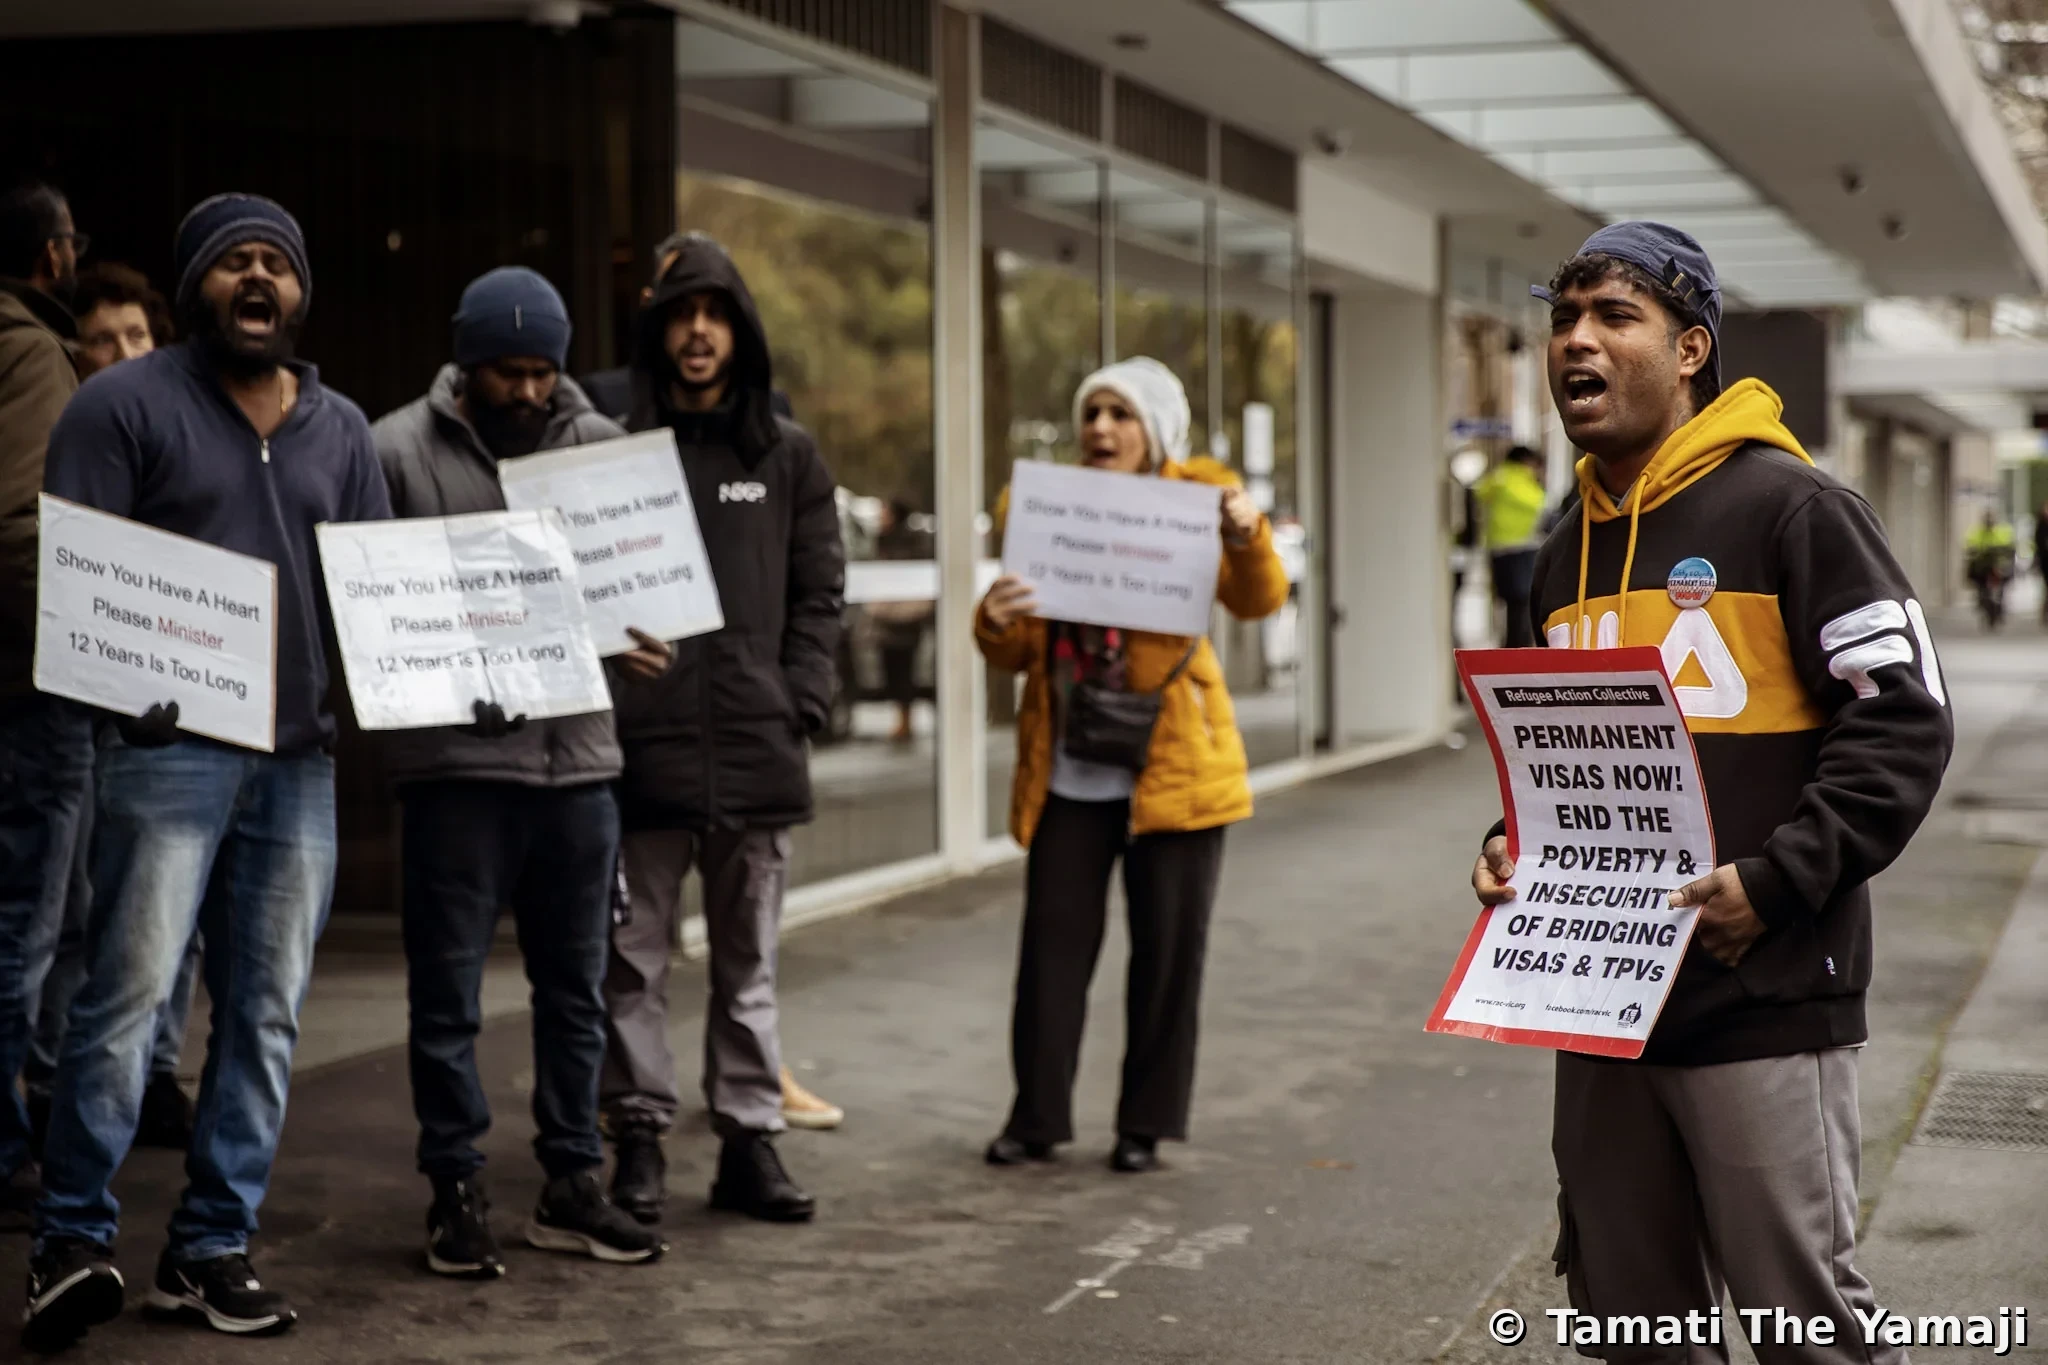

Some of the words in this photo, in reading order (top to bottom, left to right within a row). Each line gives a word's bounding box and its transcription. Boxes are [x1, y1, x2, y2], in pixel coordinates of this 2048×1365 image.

[596, 503, 632, 522] Have
[633, 497, 643, 511] A
[643, 490, 680, 510] Heart
[56, 546, 106, 577] Show
[111, 563, 144, 588] You
[149, 573, 193, 603] Have
[196, 588, 210, 608] A
[214, 592, 260, 622] Heart
[344, 579, 396, 599] Show
[400, 577, 434, 596] You
[439, 574, 487, 593] Have
[491, 569, 506, 589] A
[509, 566, 563, 586] Heart
[93, 596, 152, 631] Please
[158, 615, 224, 650] Minister
[391, 614, 453, 634] Please
[458, 609, 529, 632] Minister
[69, 631, 90, 654] 12
[95, 637, 144, 669] Years
[150, 653, 164, 674] Is
[170, 657, 200, 684] Too
[205, 669, 247, 700] Long
[377, 655, 398, 674] 12
[401, 653, 453, 671] Years
[478, 647, 513, 667] Too
[517, 642, 565, 662] Long
[1505, 689, 1553, 704] Refugee
[1554, 688, 1592, 701] Action
[1592, 687, 1650, 701] Collective
[1513, 725, 1676, 750] PERMANENT
[1528, 764, 1605, 791] VISAS
[1612, 764, 1684, 792] NOW!
[1556, 804, 1612, 830] END
[1617, 806, 1672, 833] THE
[1538, 845, 1666, 873] POVERTY
[1676, 849, 1697, 876] &
[1508, 914, 1544, 937] OF
[1547, 917, 1677, 947] BRIDGING
[1492, 947, 1567, 974] VISAS
[1572, 954, 1592, 977] &
[1601, 956, 1665, 982] TPVs
[1475, 997, 1526, 1010] www.rac-vic.org
[1545, 1003, 1612, 1017] facebook.com/racvic
